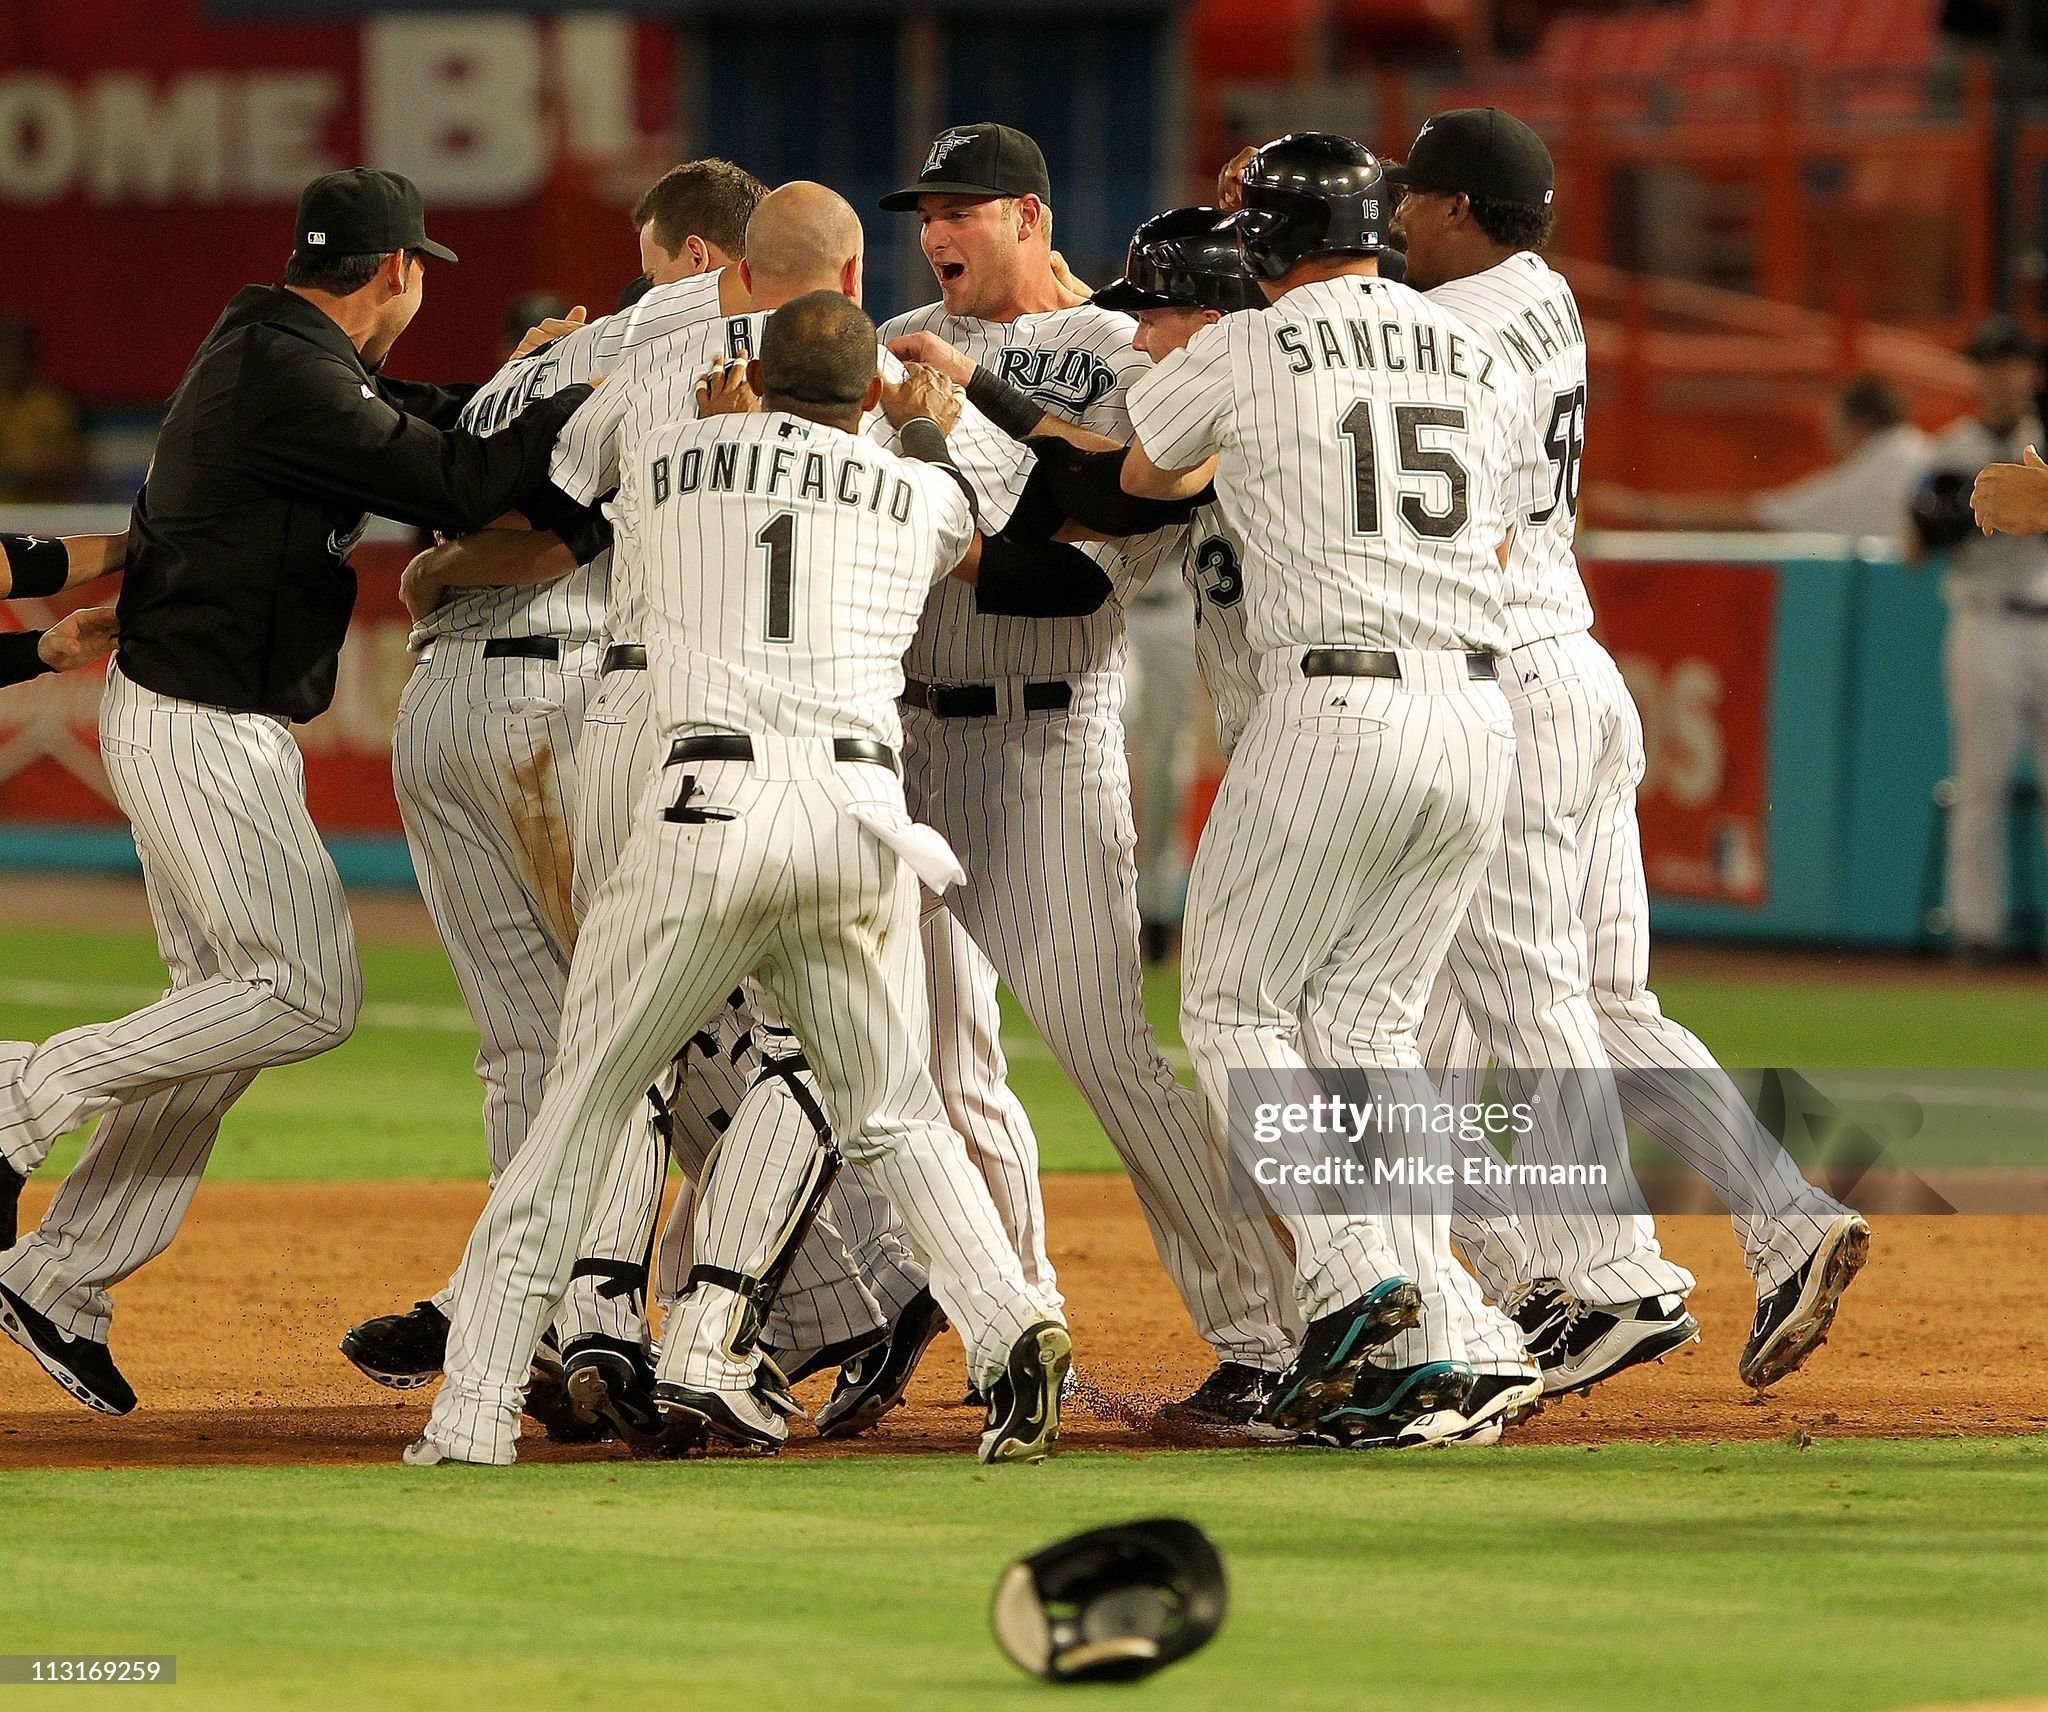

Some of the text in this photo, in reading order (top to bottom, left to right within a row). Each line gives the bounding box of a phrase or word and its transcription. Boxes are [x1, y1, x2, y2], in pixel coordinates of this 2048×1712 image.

[1361, 198, 1379, 220] 15
[1274, 317, 1497, 394] SANCHEZ
[651, 441, 914, 526] BONIFACIO
[1336, 396, 1472, 543] 15
[754, 508, 798, 644] 1
[1194, 533, 1245, 610] 3
